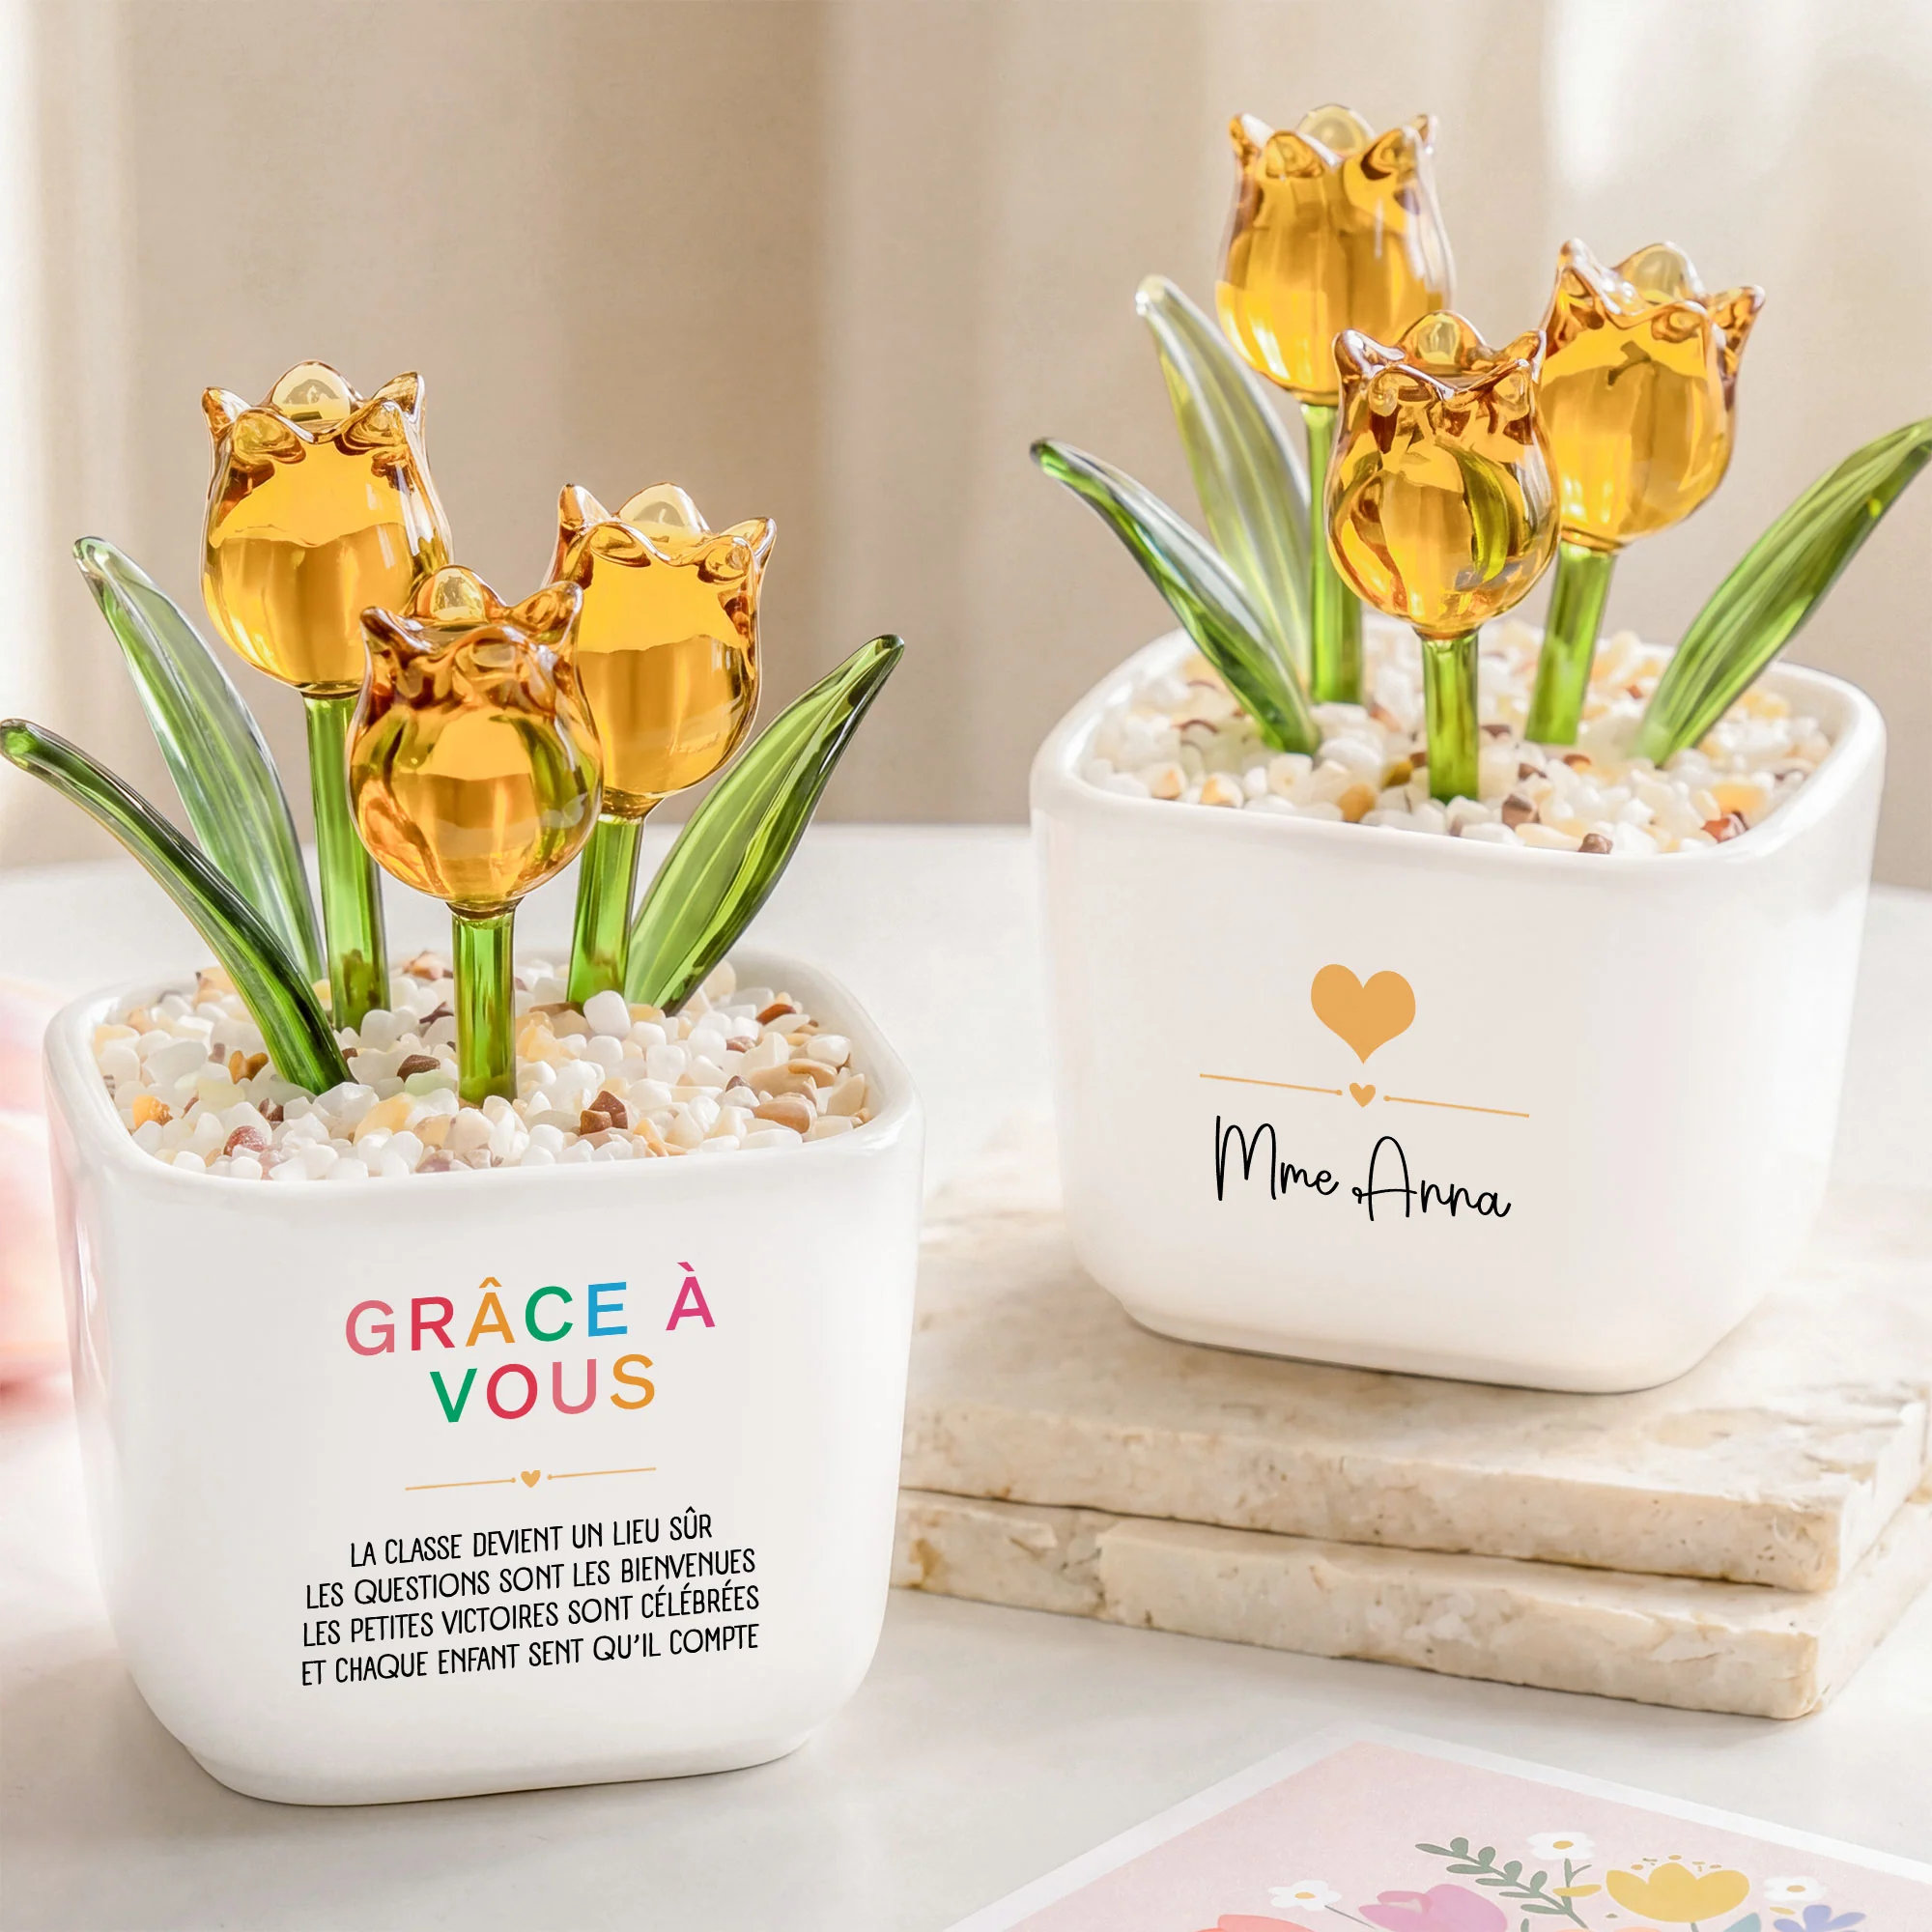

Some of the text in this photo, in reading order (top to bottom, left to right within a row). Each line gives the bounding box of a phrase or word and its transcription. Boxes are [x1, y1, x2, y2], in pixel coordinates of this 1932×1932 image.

[1215, 1115, 1512, 1222] Mme Anna
[345, 1261, 716, 1356] GRÂCE À
[429, 1353, 656, 1423] VOUS
[350, 1505, 713, 1568] LA CLASSE DEVIENT UN LIEU SÛR
[302, 1578, 759, 1647] LES PETITES VICTOIRES SONT CÉLÉBRÉES
[306, 1548, 755, 1609] LES QUESTIONS SONT LES BIENVENUES
[301, 1659, 327, 1687] ET
[335, 1651, 429, 1684] CHAQUE
[438, 1643, 521, 1675] ENFANT
[528, 1637, 584, 1667] SENT
[669, 1623, 760, 1656] COMPTE
